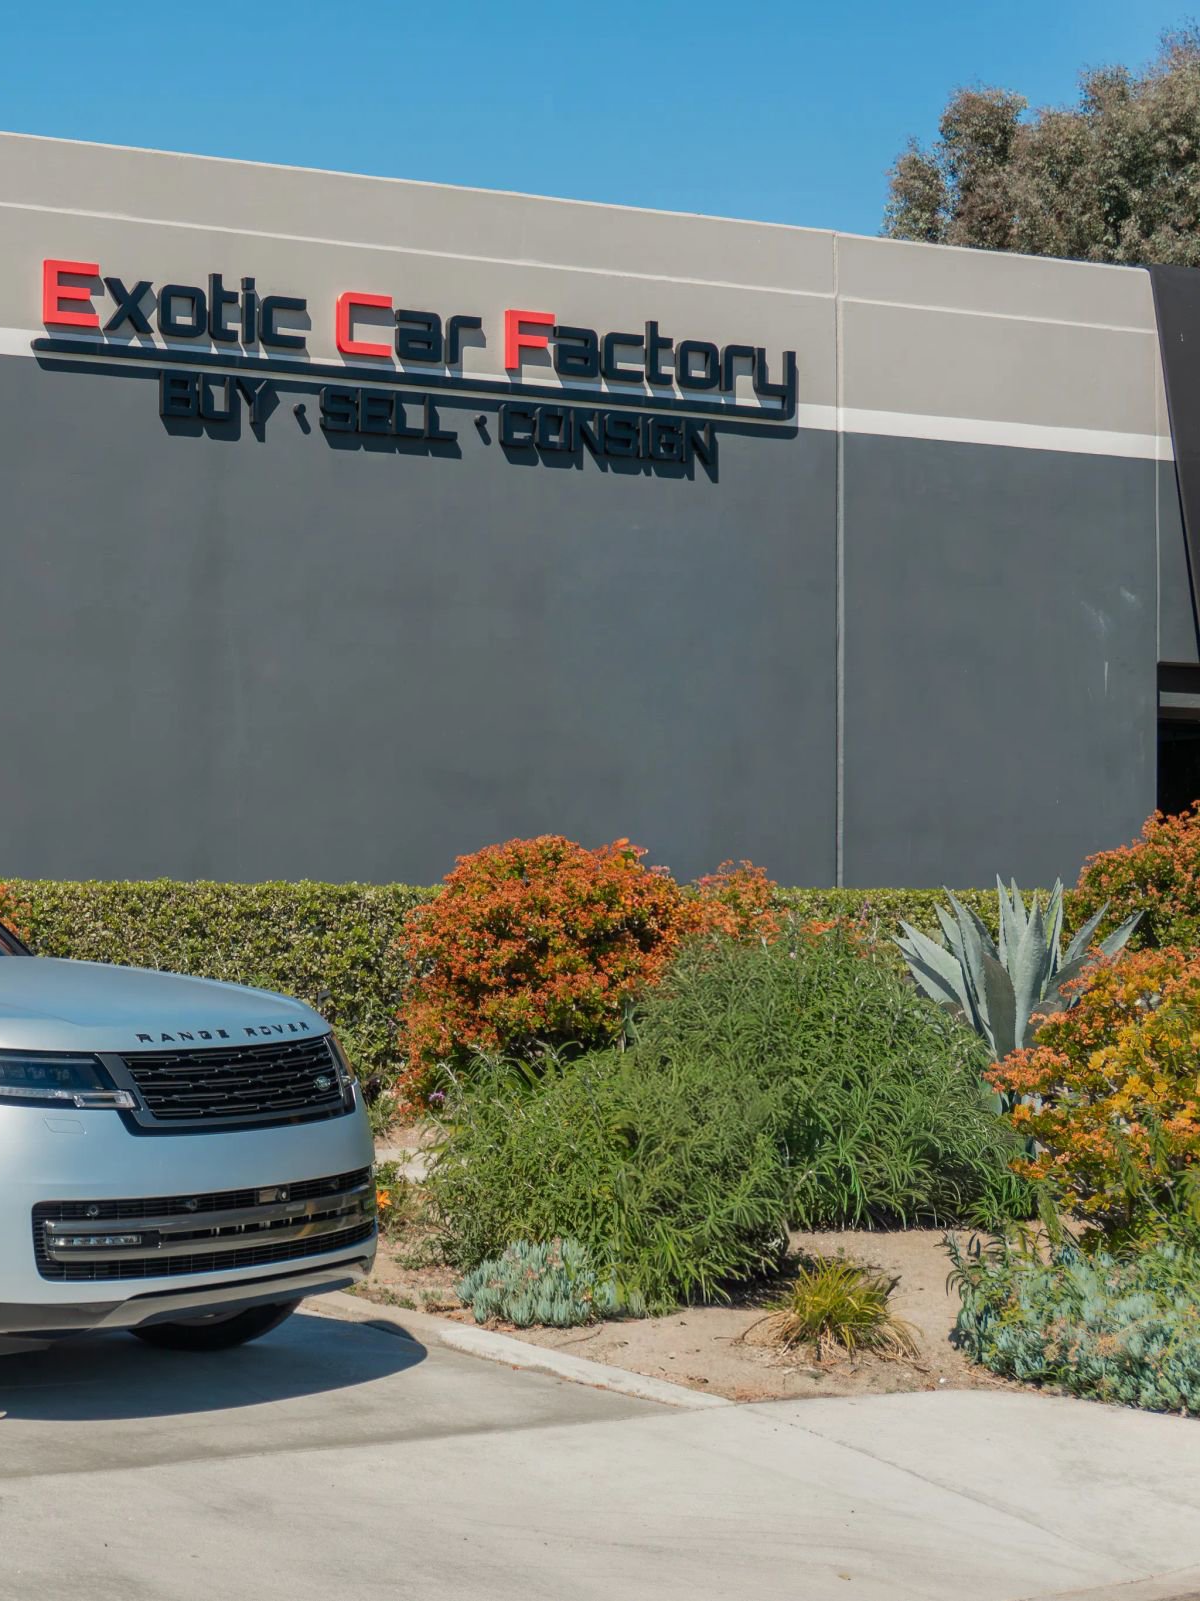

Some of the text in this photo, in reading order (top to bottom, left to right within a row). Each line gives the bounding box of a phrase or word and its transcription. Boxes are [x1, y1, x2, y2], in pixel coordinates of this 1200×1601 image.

[43, 258, 796, 421] Exotic Car Factory
[159, 369, 718, 466] BUY SELL CONSIGN
[136, 1021, 311, 1043] RANGE ROVER
